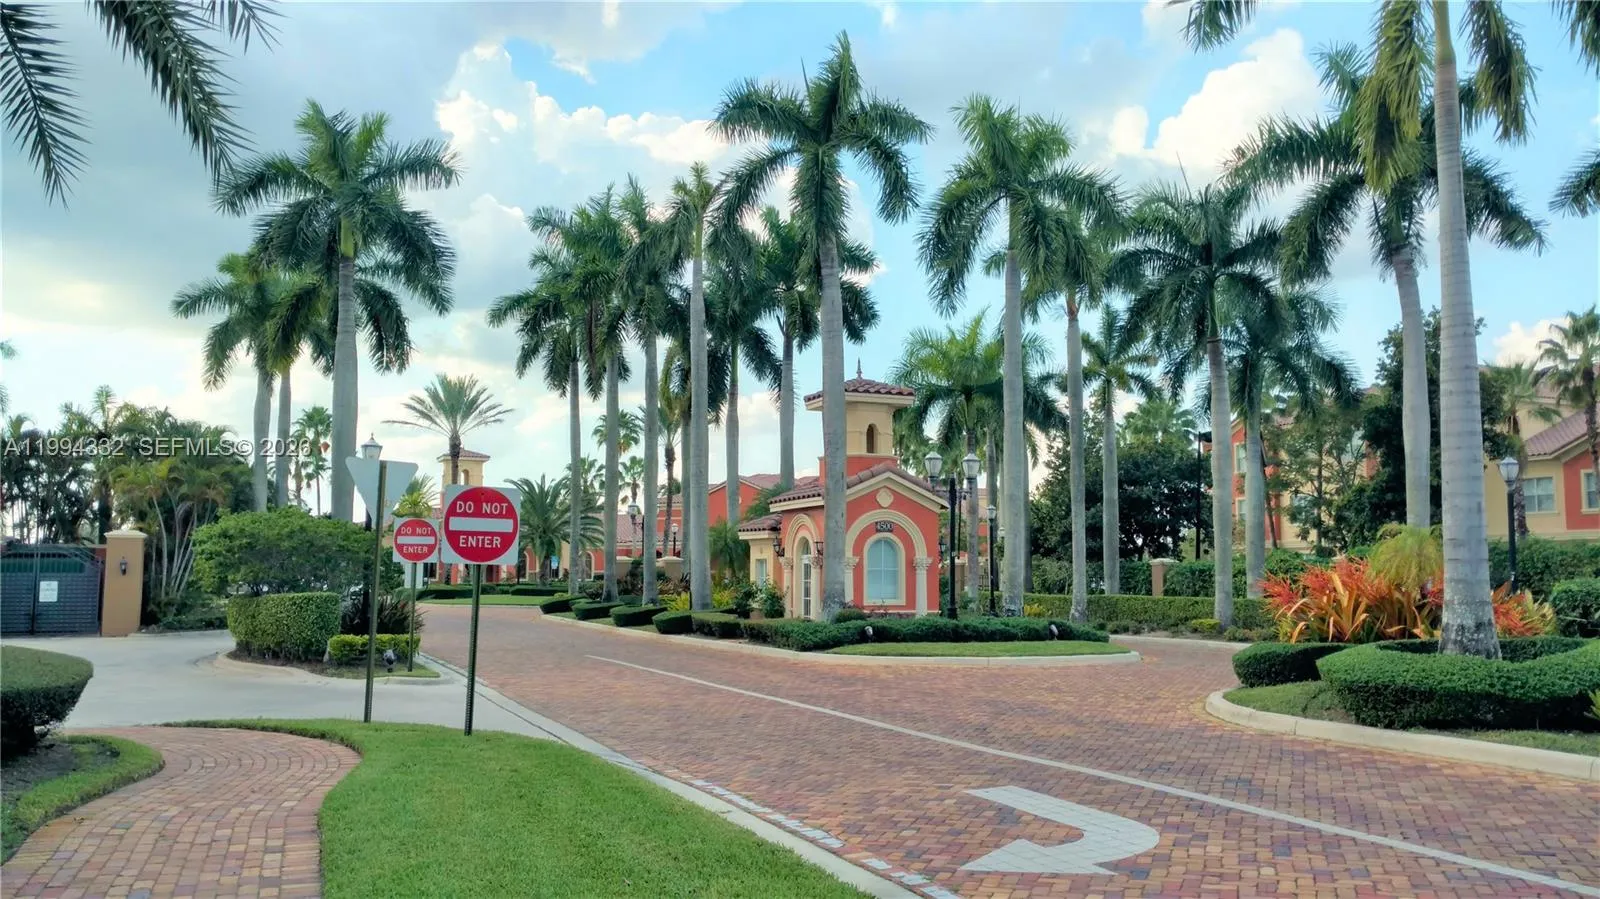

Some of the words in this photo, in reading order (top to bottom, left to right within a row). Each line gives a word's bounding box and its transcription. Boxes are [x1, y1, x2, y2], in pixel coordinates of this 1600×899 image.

[456, 501, 474, 513] DO
[482, 502, 509, 515] NOT
[401, 526, 412, 535] DO
[416, 527, 432, 535] NOT
[459, 535, 501, 548] ENTER
[403, 546, 428, 554] ENTER
